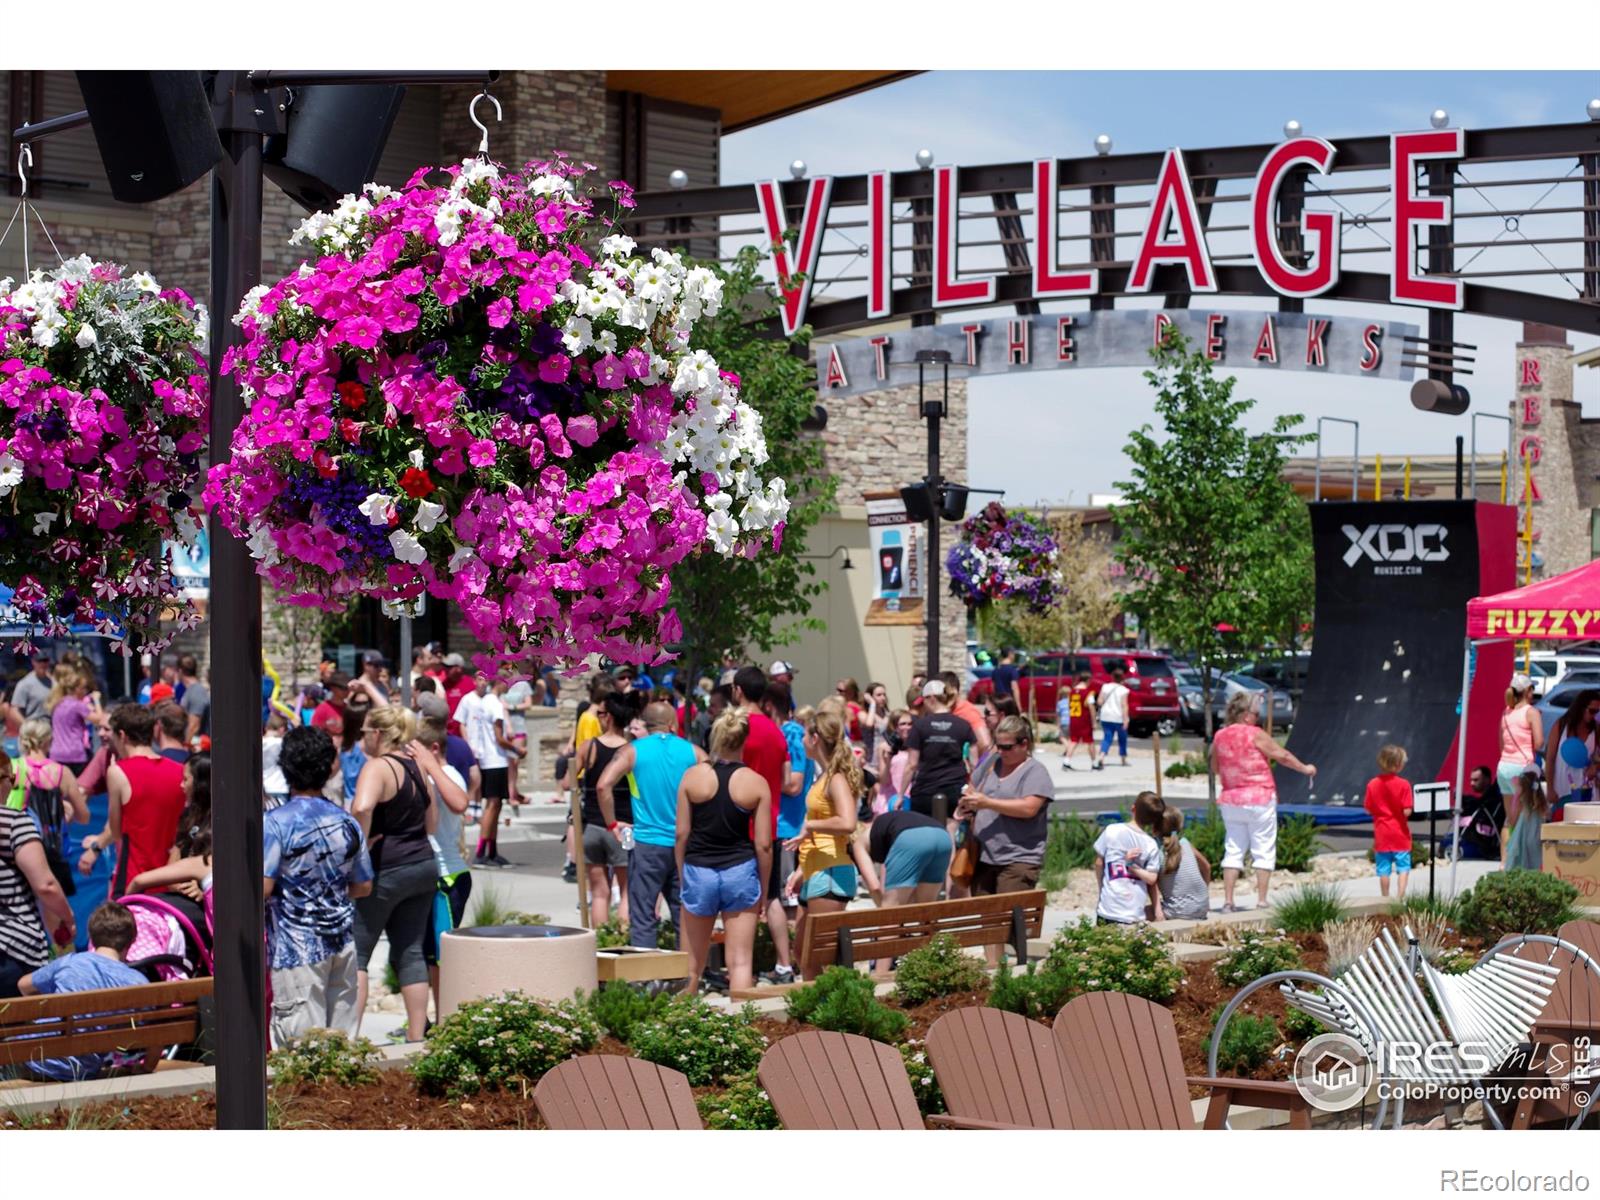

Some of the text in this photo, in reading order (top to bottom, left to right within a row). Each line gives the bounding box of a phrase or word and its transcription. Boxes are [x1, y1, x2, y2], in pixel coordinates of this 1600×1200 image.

[755, 127, 1465, 335] VILLAGE
[824, 336, 892, 389] AT
[961, 315, 1076, 366] THE
